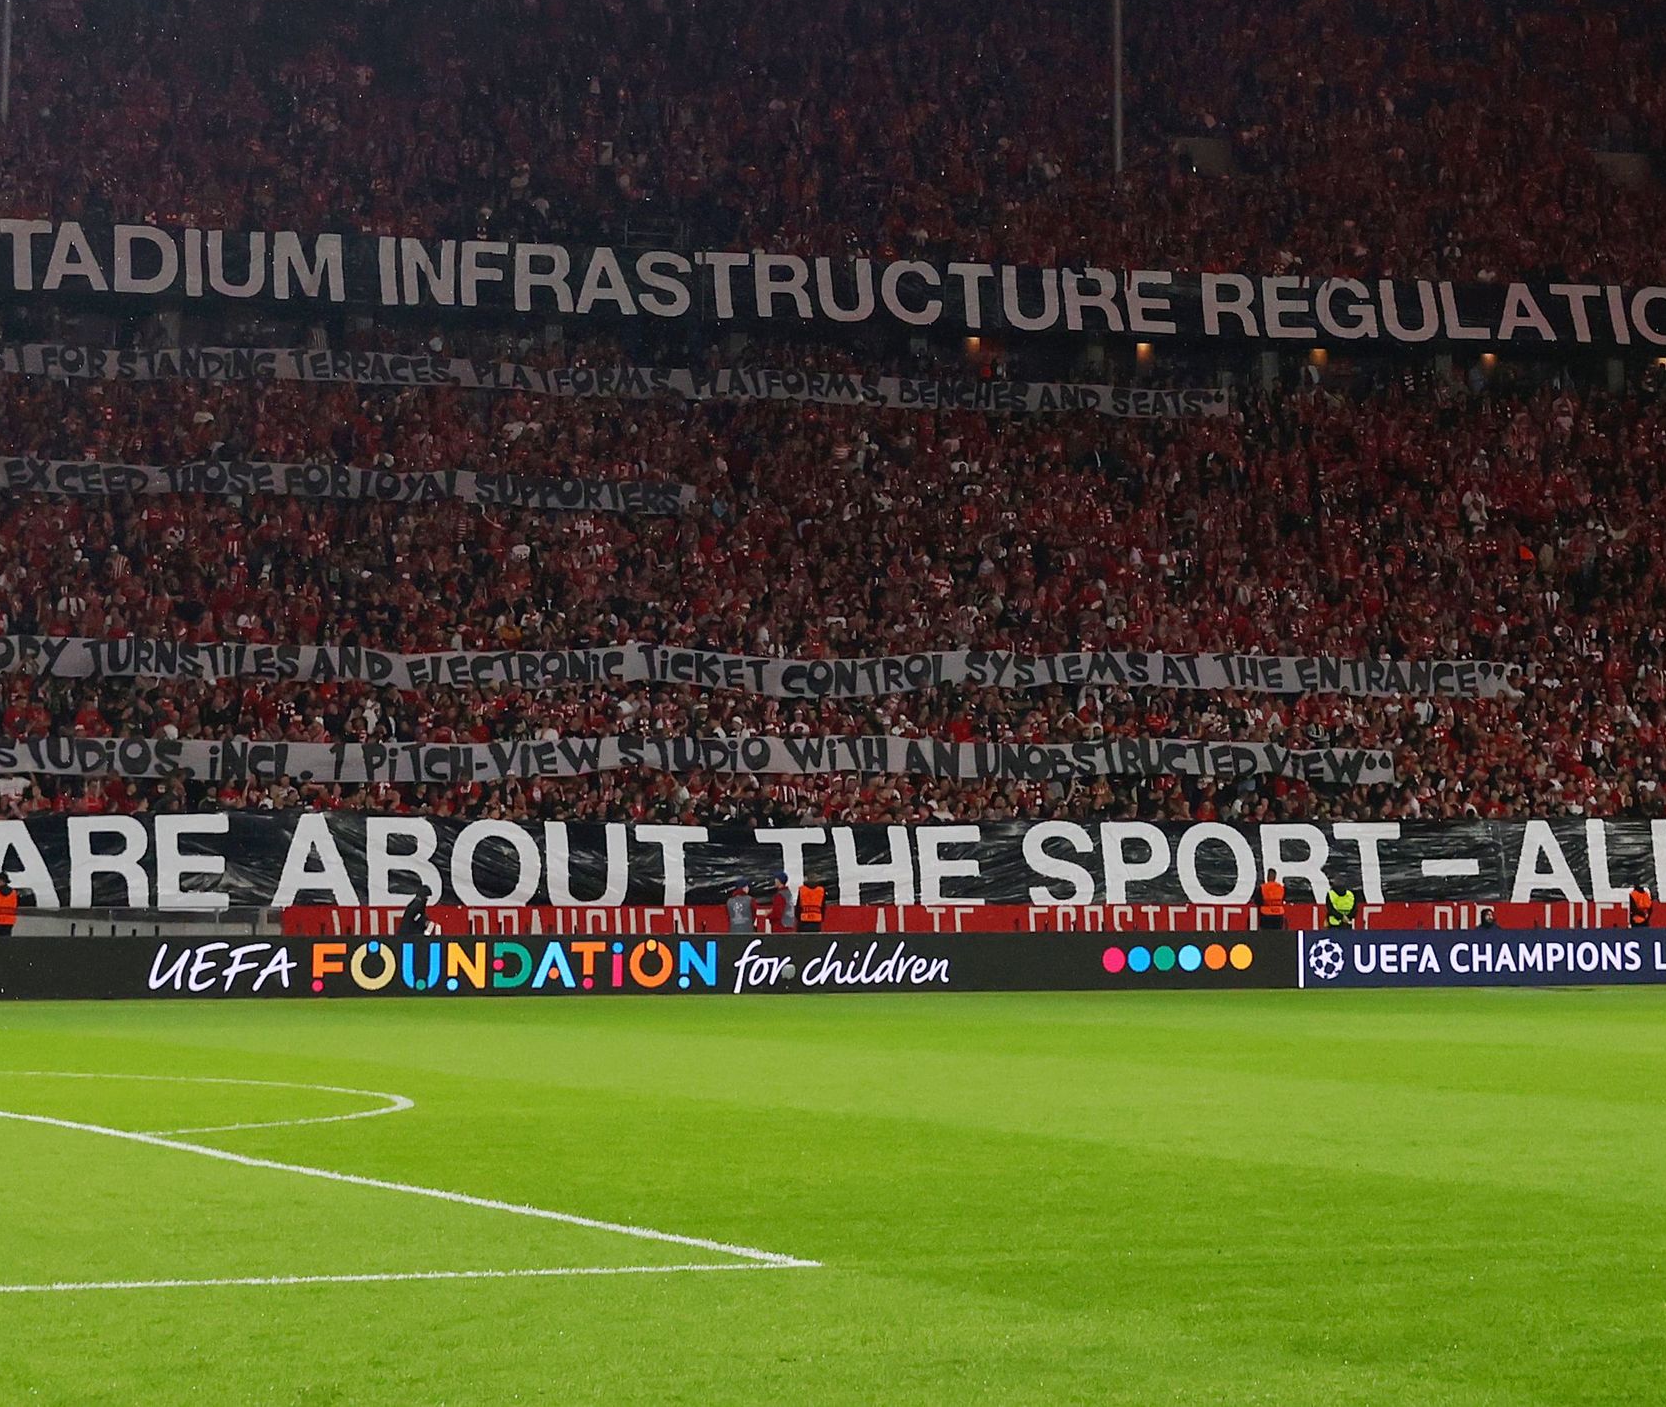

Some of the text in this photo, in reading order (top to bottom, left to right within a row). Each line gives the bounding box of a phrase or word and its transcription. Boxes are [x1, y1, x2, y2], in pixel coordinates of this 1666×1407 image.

[378, 235, 1177, 335] INFRASTRUCTURE
[43, 343, 109, 378] FOR
[117, 347, 276, 379] STANDING
[900, 380, 1027, 411] BENCHES
[1038, 382, 1100, 410] AND
[5, 457, 147, 494] EXCEED
[160, 461, 275, 496] THOSE
[284, 463, 351, 498] FOR
[475, 472, 683, 514] SUPPORTERS
[85, 636, 301, 681] TURNSTILES
[310, 647, 393, 683] AND
[407, 649, 625, 690] ELECTRONIC
[638, 644, 770, 686] TICKET
[782, 653, 952, 698] CONTROL
[965, 650, 1150, 686] SYSTEMS
[1162, 653, 1201, 687] AT
[1213, 654, 1282, 688] THE
[330, 741, 346, 780] 1
[362, 736, 603, 781] PITCH-VIEW
[617, 733, 771, 774] STUDIO
[783, 736, 889, 773] WITH
[905, 738, 959, 776] AN
[975, 739, 1258, 778] UNOBSTRUCTED
[270, 812, 708, 909] ABOUT
[754, 825, 988, 909] THE
[1020, 820, 1401, 907] SPORT
[148, 939, 950, 994] UEFA FOUNDATION for children
[1353, 942, 1441, 974] UEFA
[1449, 940, 1642, 973] CHAMPIONS
